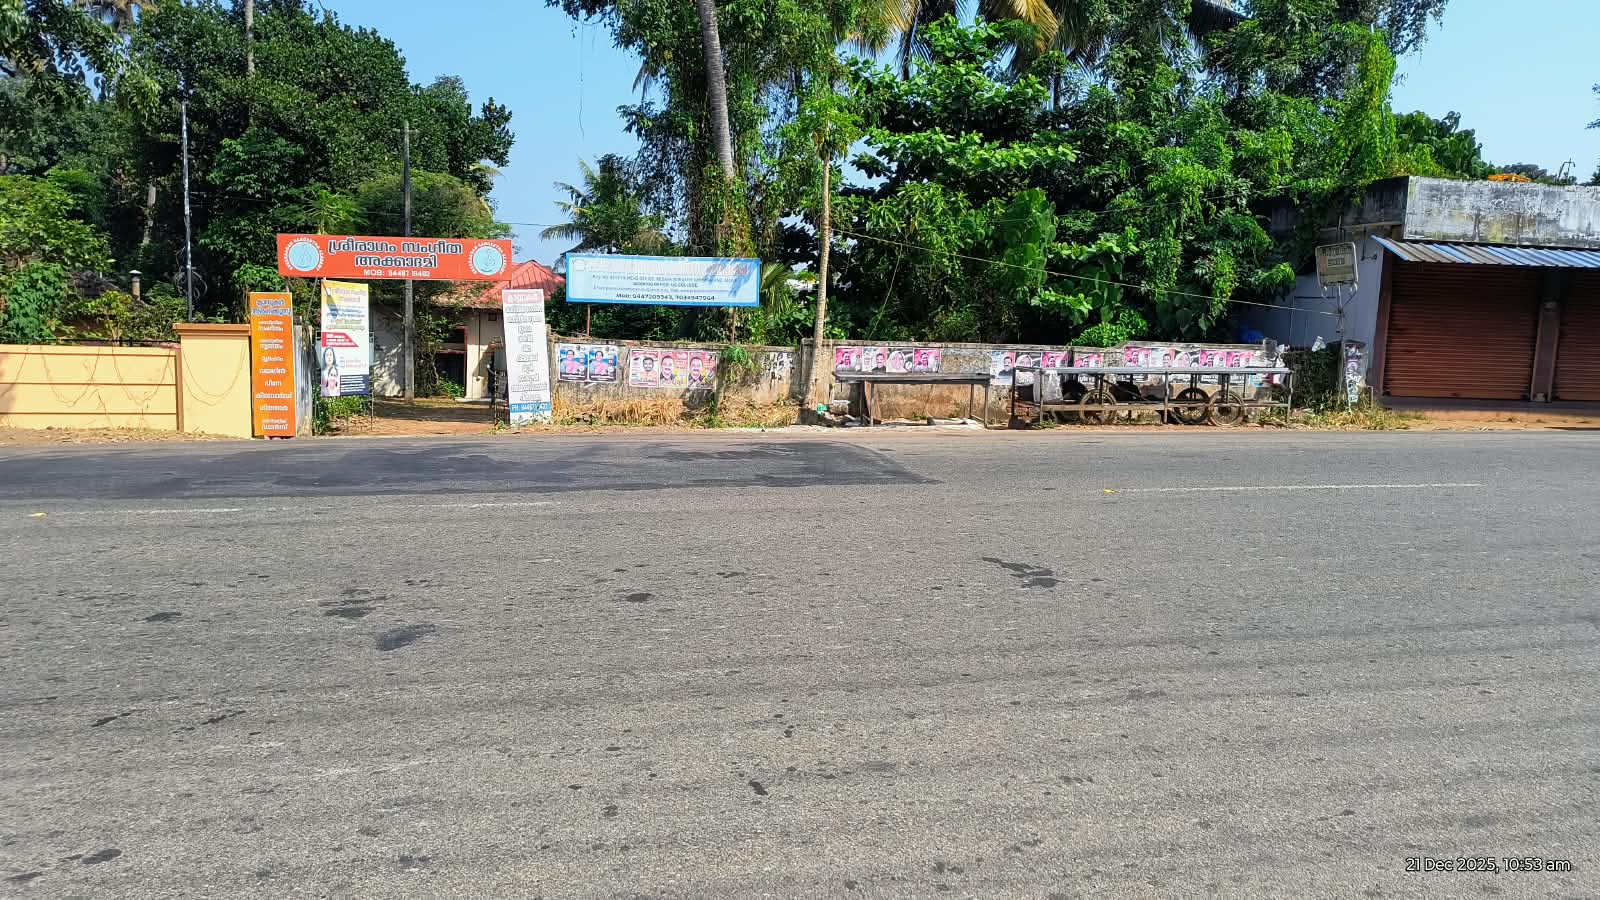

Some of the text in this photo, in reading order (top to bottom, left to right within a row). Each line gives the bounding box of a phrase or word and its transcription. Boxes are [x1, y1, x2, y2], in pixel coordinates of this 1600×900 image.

[328, 238, 464, 255] ശ്രീരാഗം സംഗീത
[354, 254, 438, 268] അക്കാദമി
